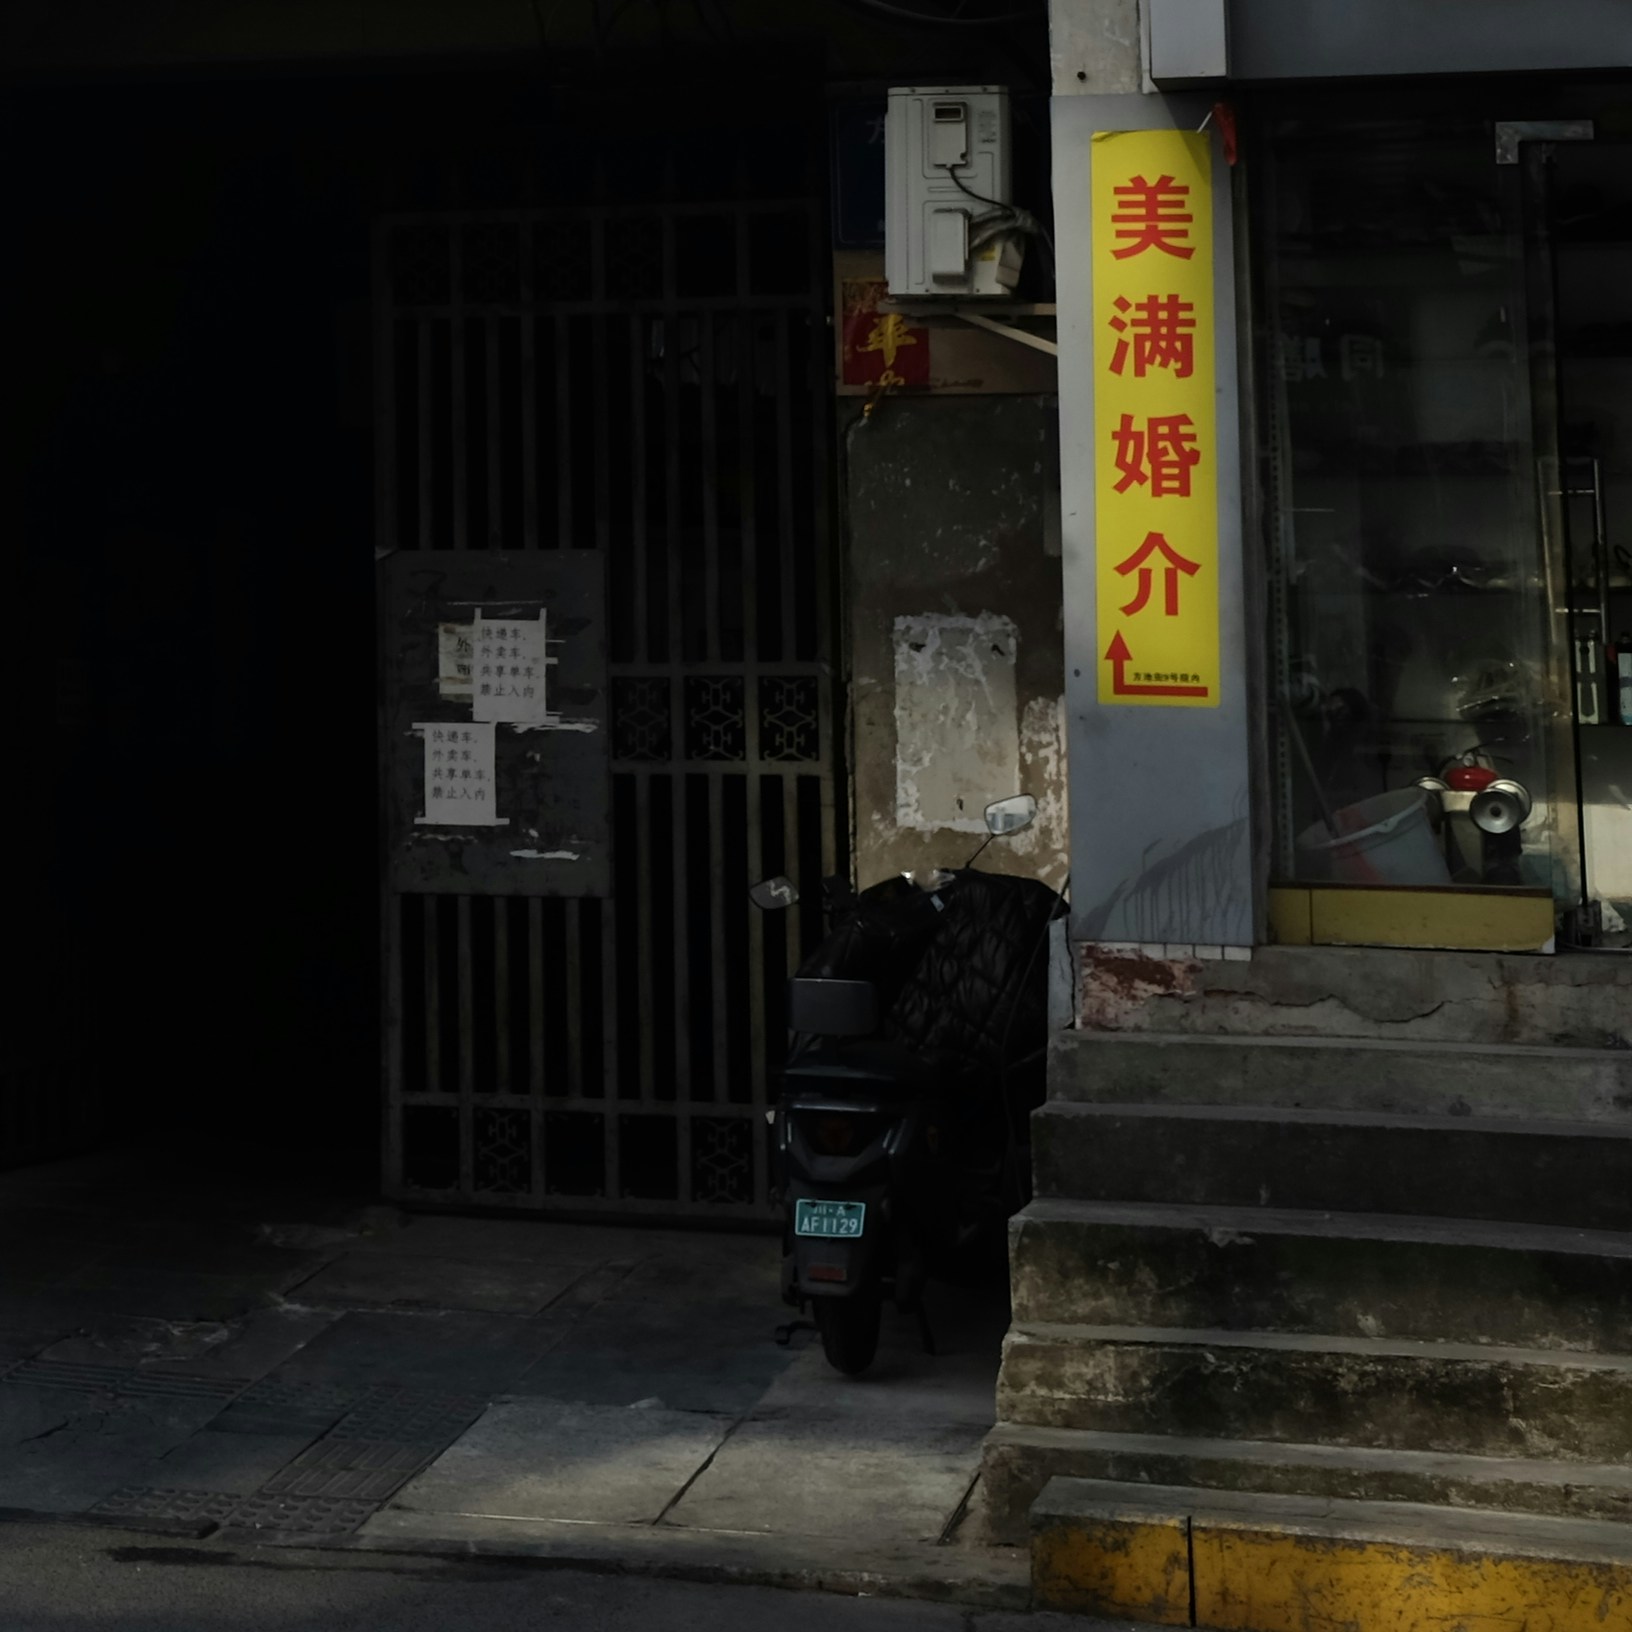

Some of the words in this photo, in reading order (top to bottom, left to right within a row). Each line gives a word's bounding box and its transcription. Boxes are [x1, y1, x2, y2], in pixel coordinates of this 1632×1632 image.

[1108, 174, 1202, 619] 美满婚介
[479, 682, 536, 699] 禁止入内
[432, 786, 487, 801] 禁止入内
[800, 1216, 858, 1234] AF1129
